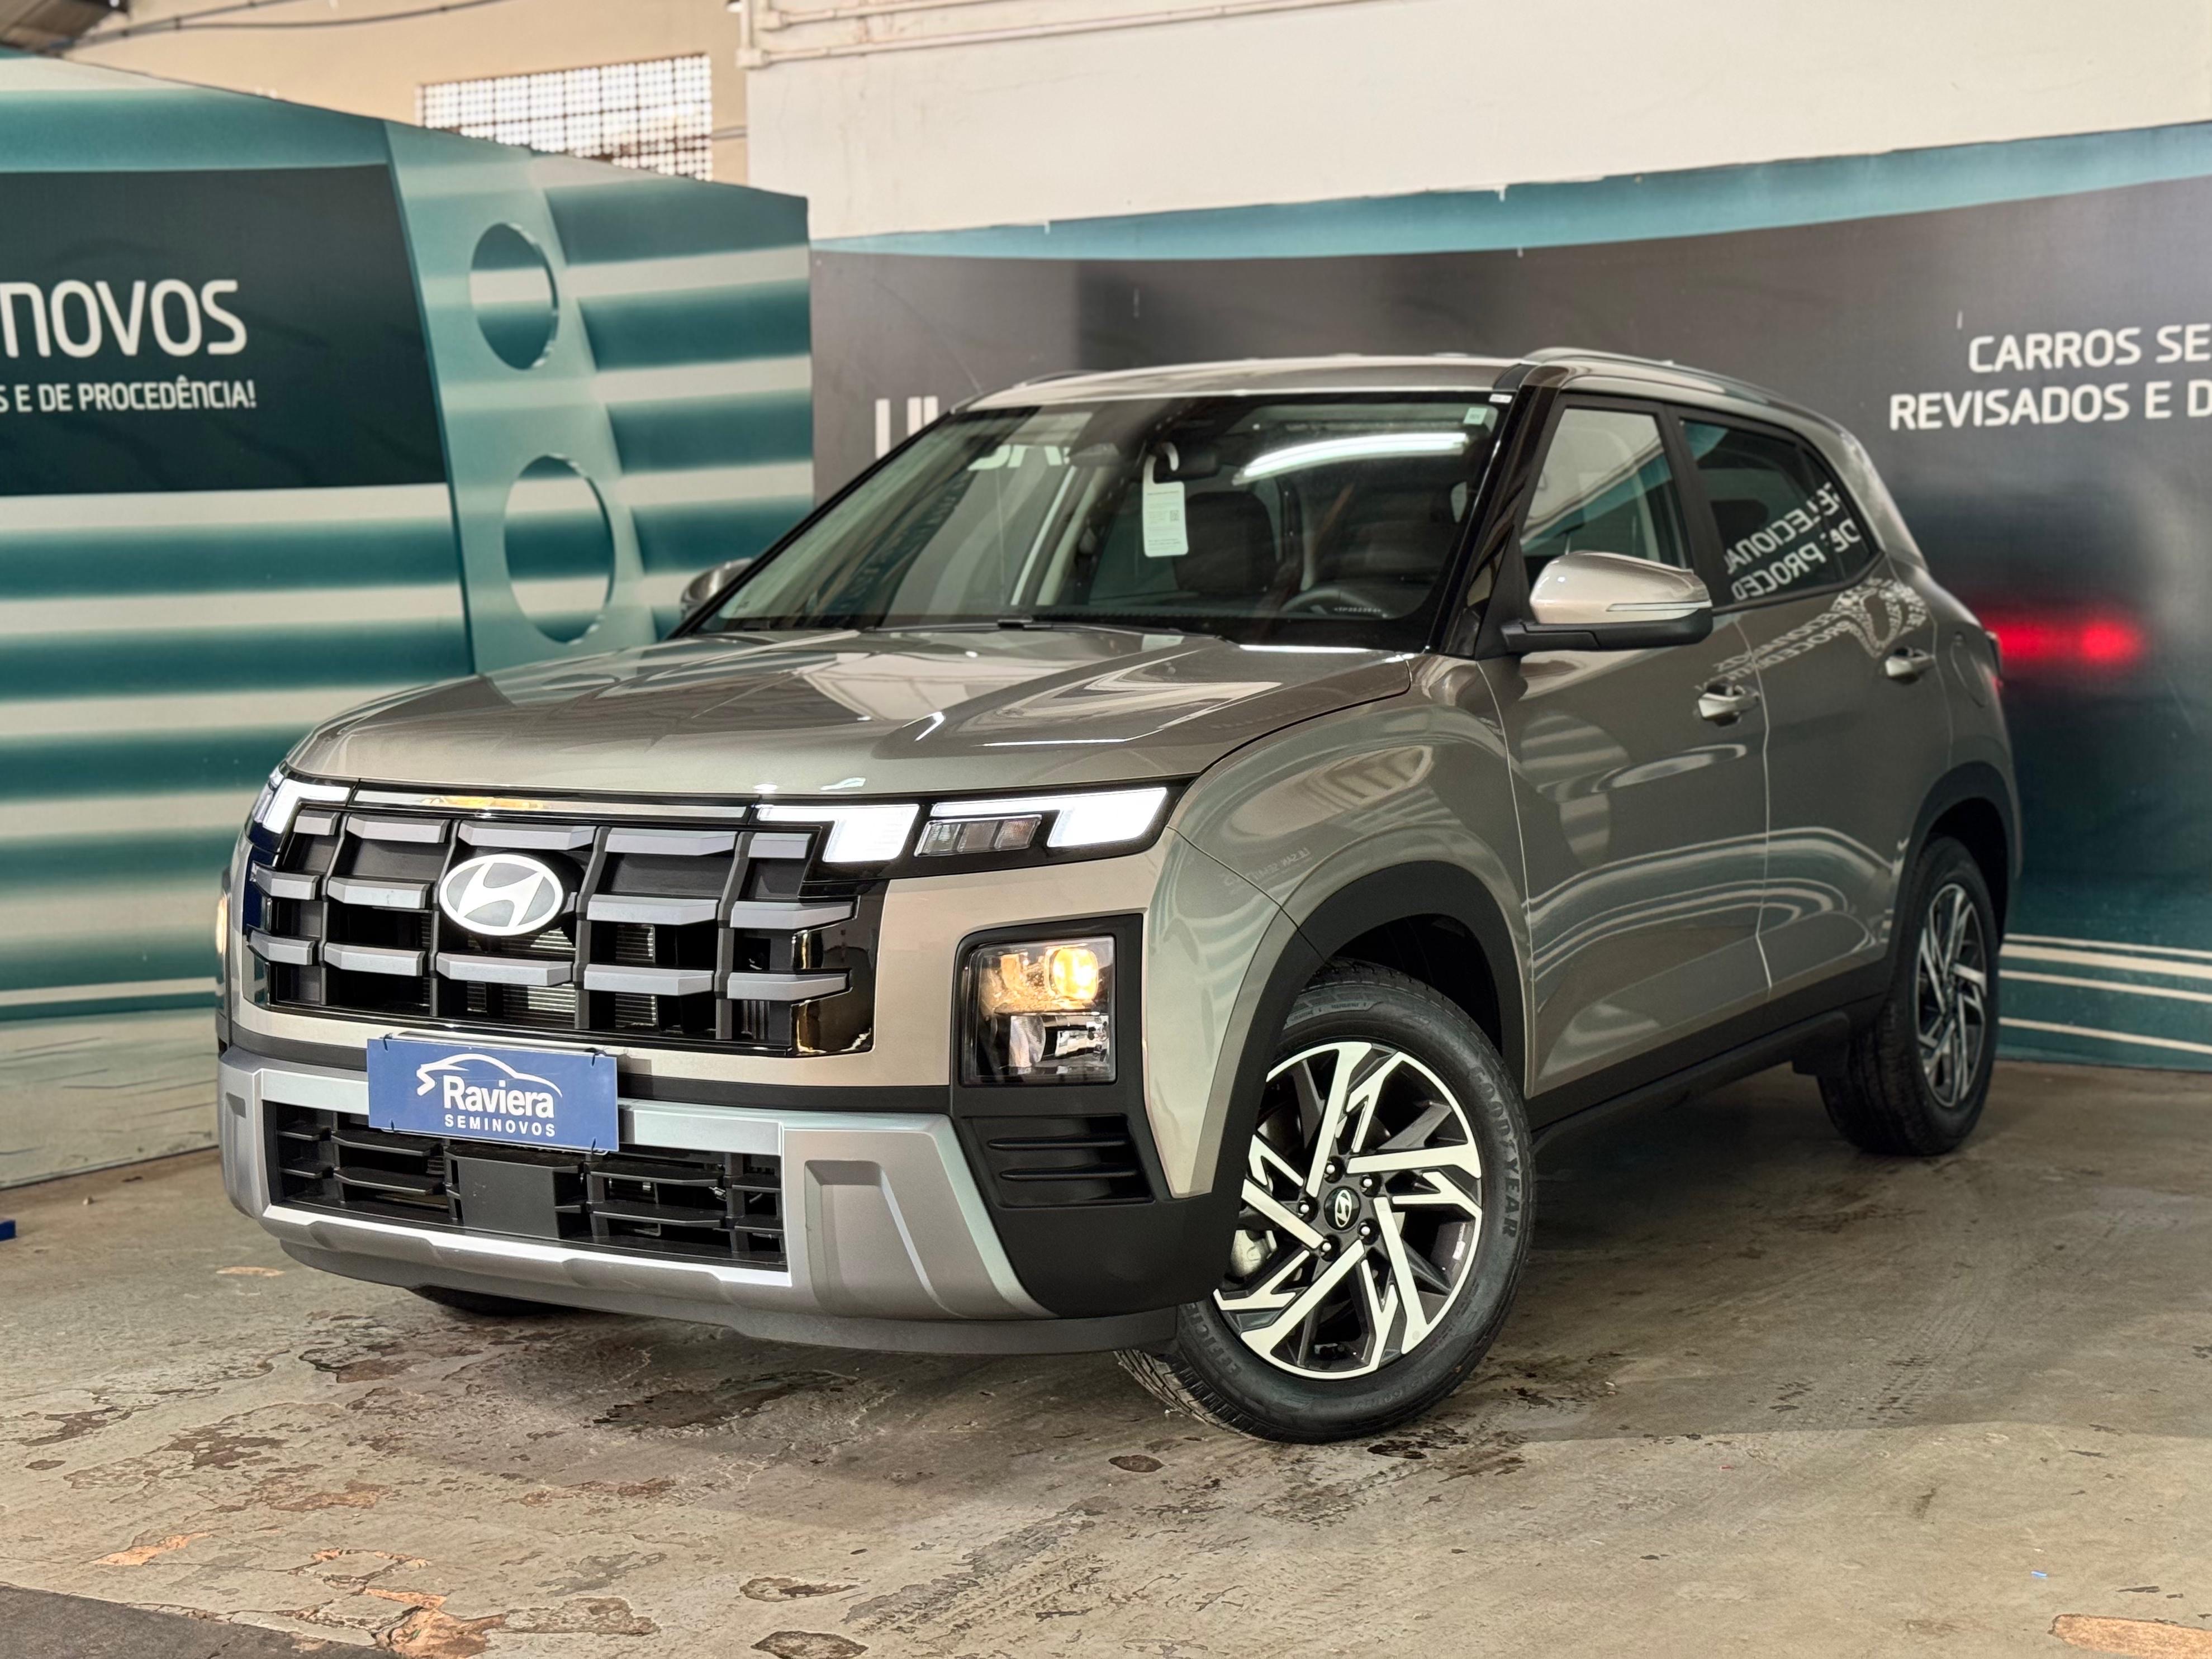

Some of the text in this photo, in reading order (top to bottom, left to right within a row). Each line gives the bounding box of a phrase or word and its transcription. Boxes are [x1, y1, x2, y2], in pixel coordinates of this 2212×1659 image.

[1968, 324, 2211, 373] CARROS SE
[15, 384, 32, 412] E
[38, 383, 73, 412] DE
[78, 375, 257, 411] PROCEDÊNCIA!
[1890, 379, 2212, 430] REVISADOS E D
[443, 1075, 555, 1118] Raviera
[445, 1114, 556, 1137] SEMINOVOS
